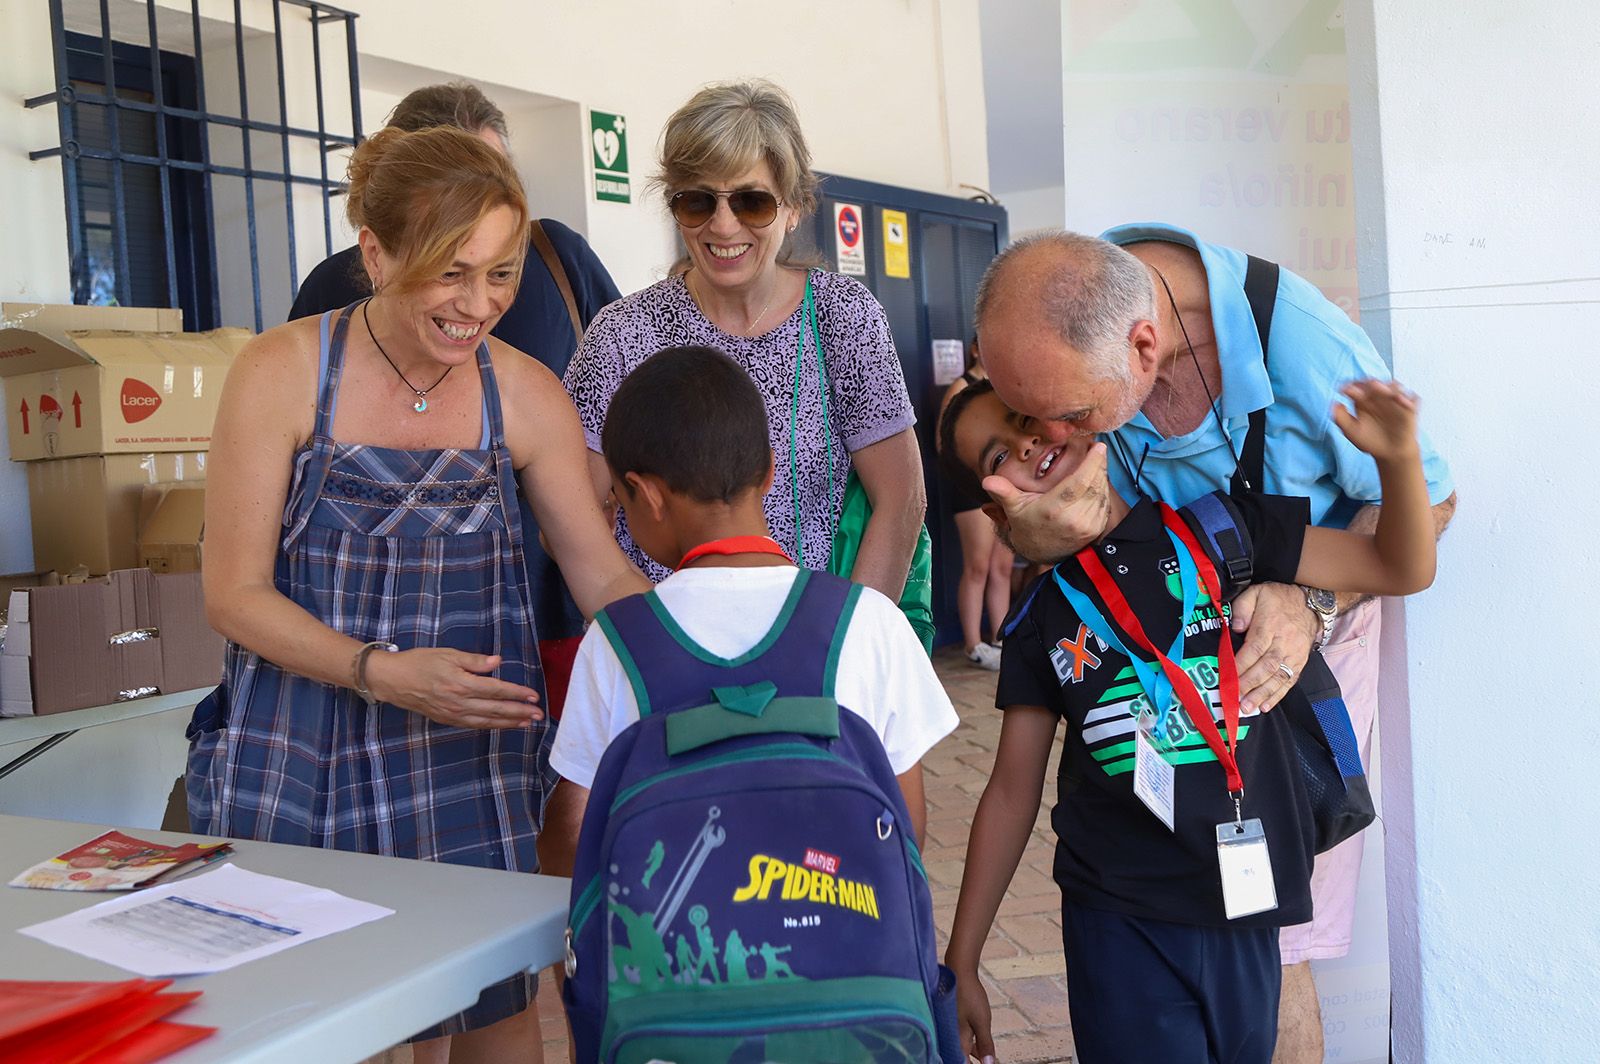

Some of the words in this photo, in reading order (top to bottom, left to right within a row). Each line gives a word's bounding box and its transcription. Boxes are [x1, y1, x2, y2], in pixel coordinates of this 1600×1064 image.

[122, 394, 159, 406] Lacer
[804, 851, 838, 873] MARVEL
[733, 854, 880, 920] SPIDER-MAN
